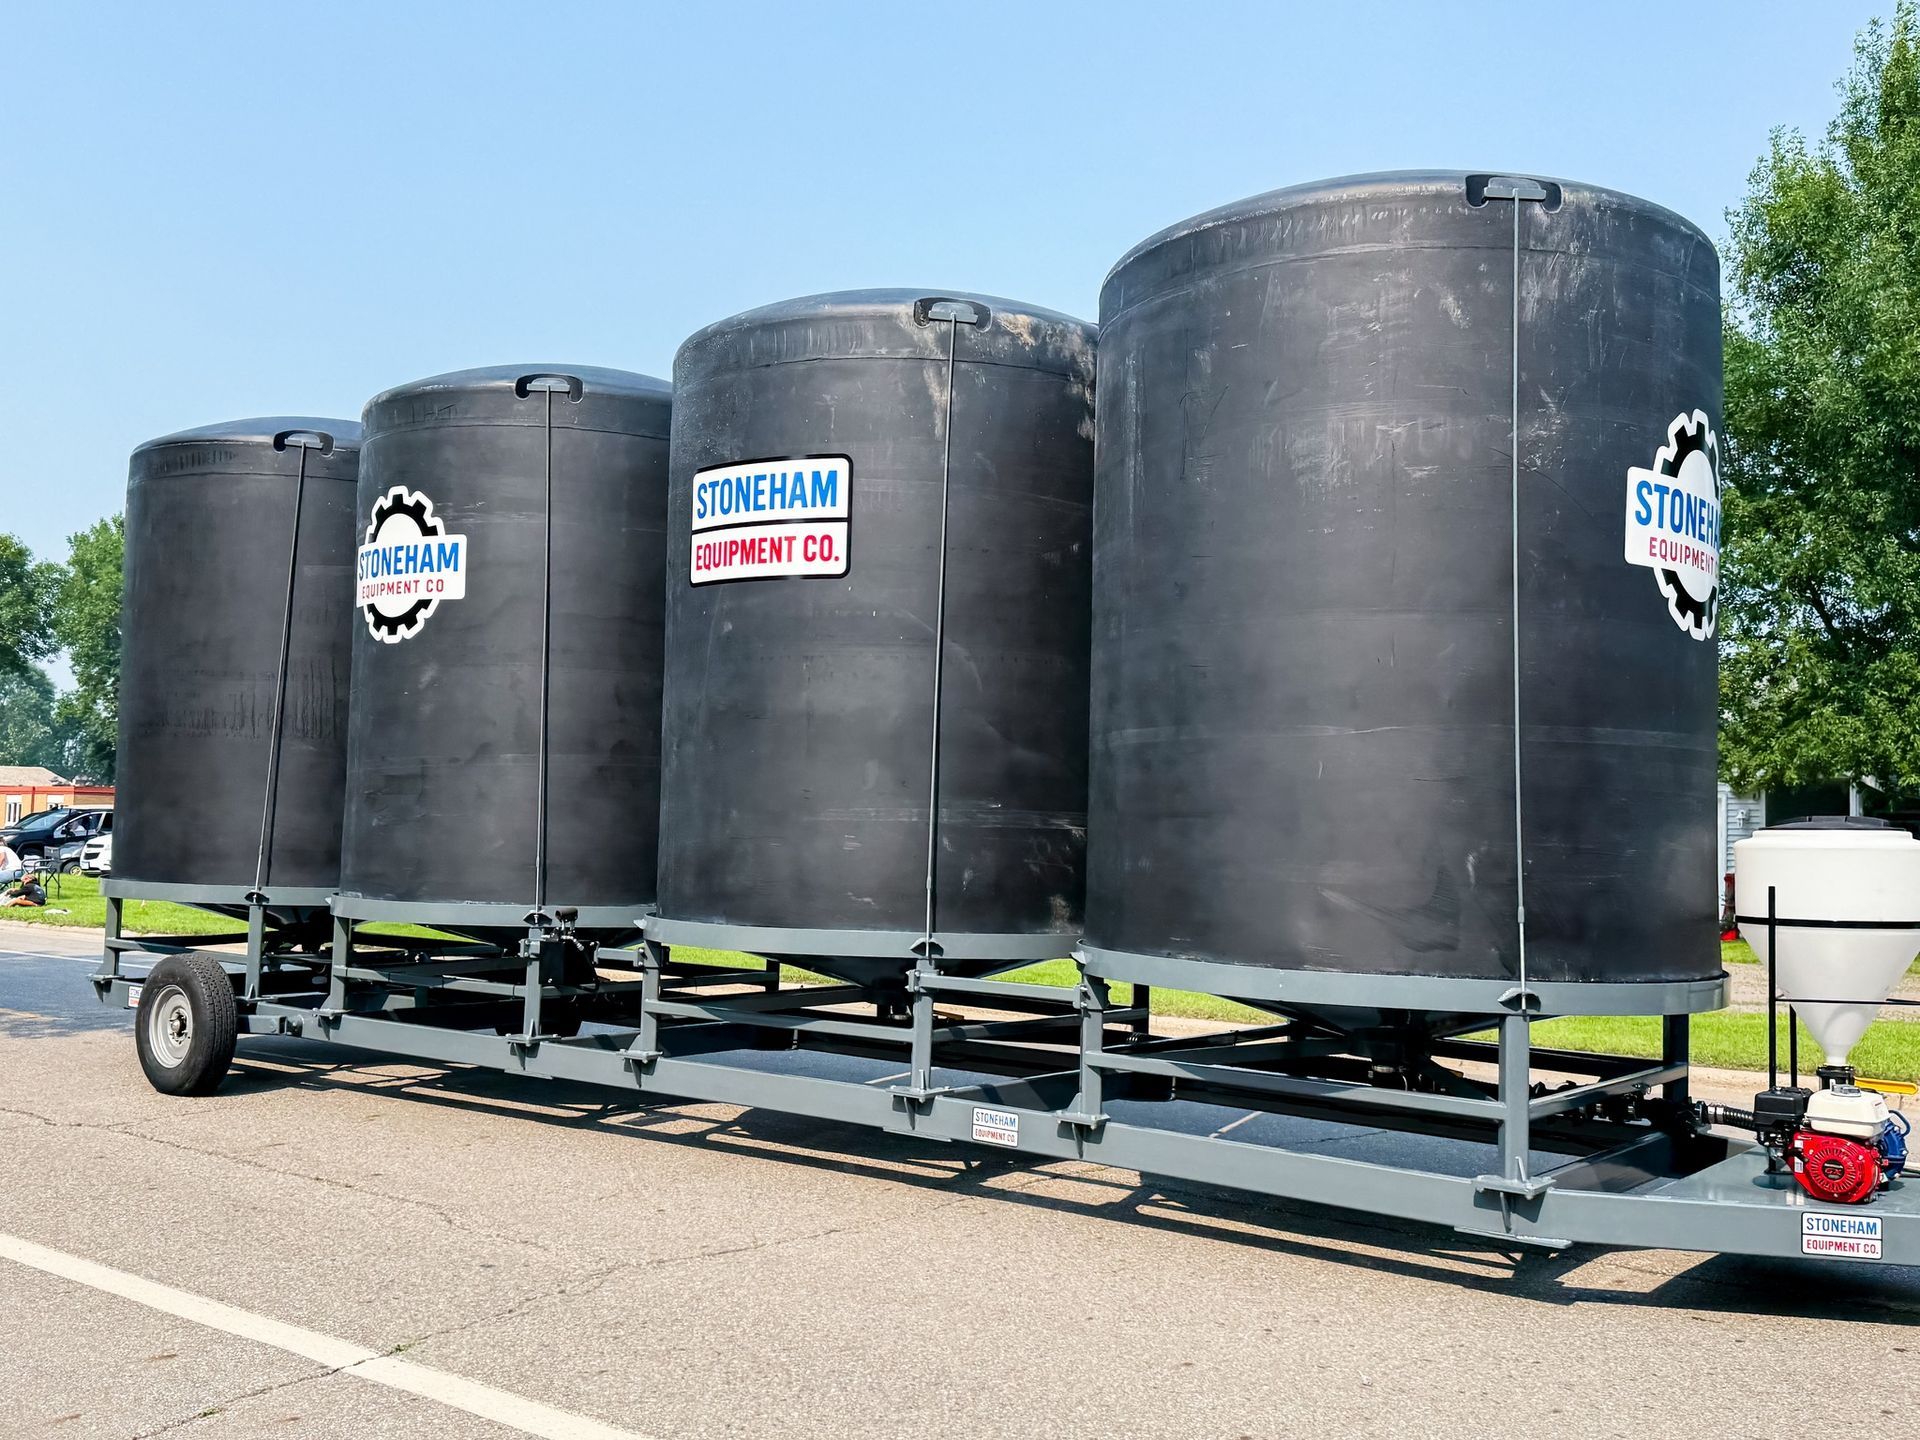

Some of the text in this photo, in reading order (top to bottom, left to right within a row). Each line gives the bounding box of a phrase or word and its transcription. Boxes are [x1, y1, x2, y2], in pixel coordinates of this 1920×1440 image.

[697, 470, 838, 519] STONEHAM
[1635, 480, 1720, 554] STONEHA
[359, 542, 460, 581] STONEHAM
[696, 534, 840, 571] EQUIPMENT CO.
[1649, 536, 1714, 576] EQUIPMENT
[362, 578, 444, 599] EQUIPMENT CO
[975, 1111, 1016, 1128] STONEHAM
[975, 1128, 1006, 1140] EQUIPMENT
[1806, 1217, 1877, 1235] STONEHAM
[1806, 1239, 1879, 1255] EQUIPMENT CO.
